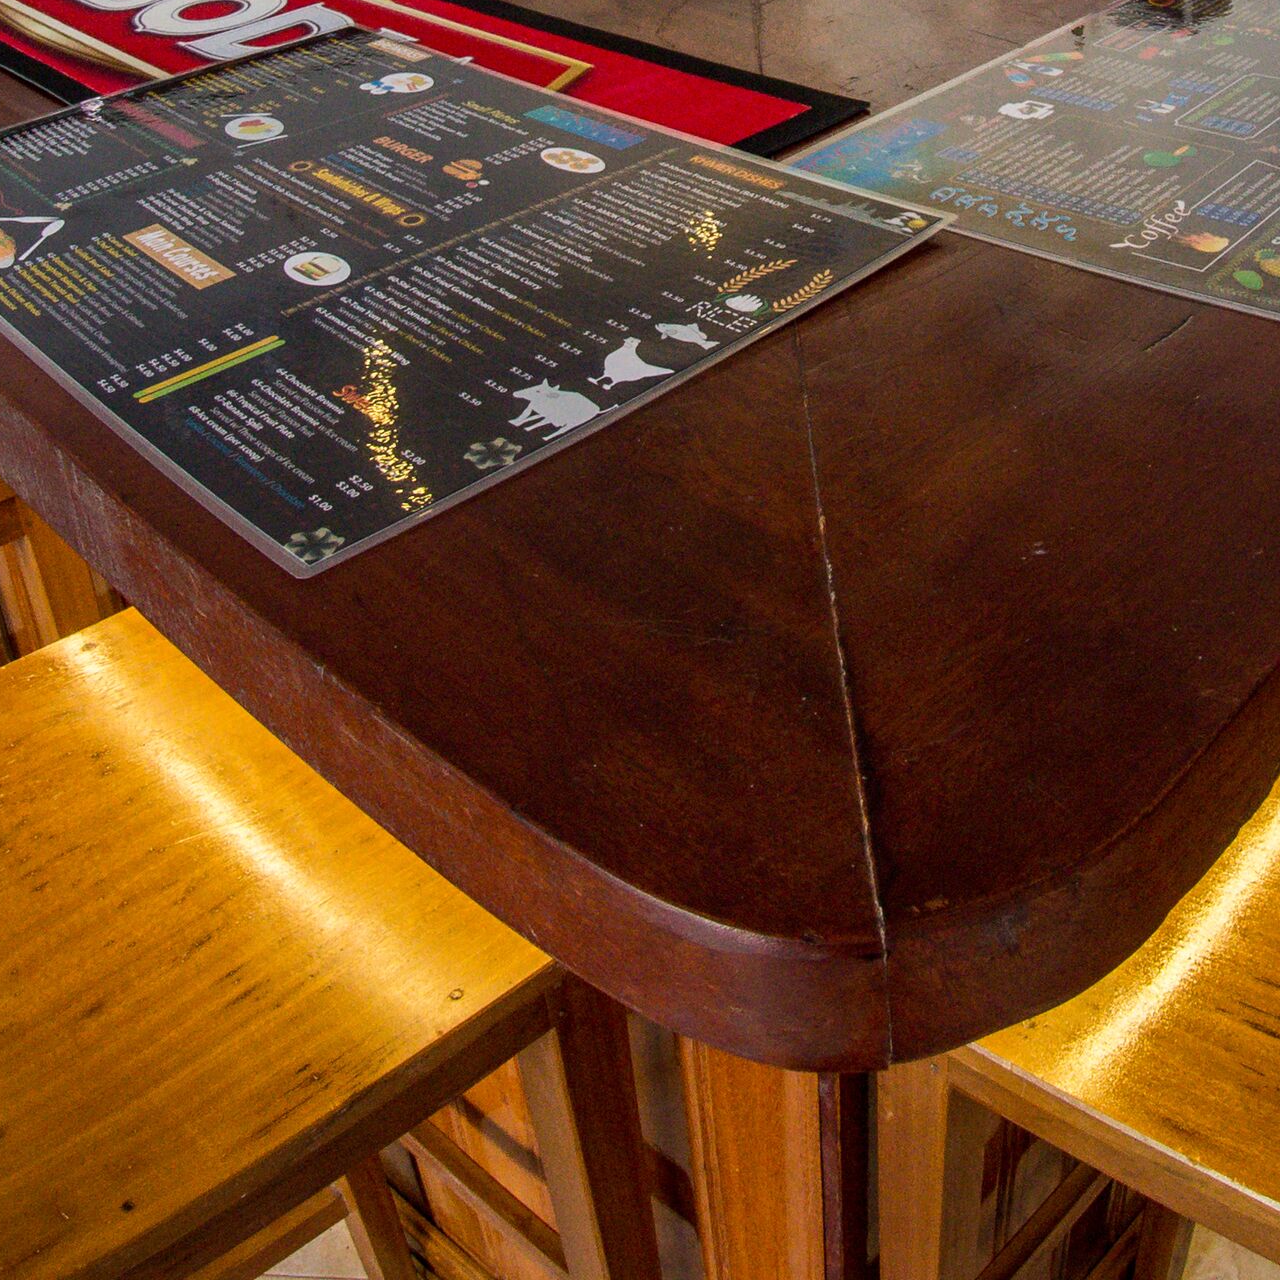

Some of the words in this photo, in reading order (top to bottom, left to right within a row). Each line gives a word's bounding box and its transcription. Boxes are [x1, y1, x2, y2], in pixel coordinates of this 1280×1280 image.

[373, 136, 433, 164] BURGER
[1126, 201, 1184, 254] Coffee
[136, 229, 173, 258] Main
[165, 247, 220, 281] Courses
[685, 300, 757, 333] RICE
